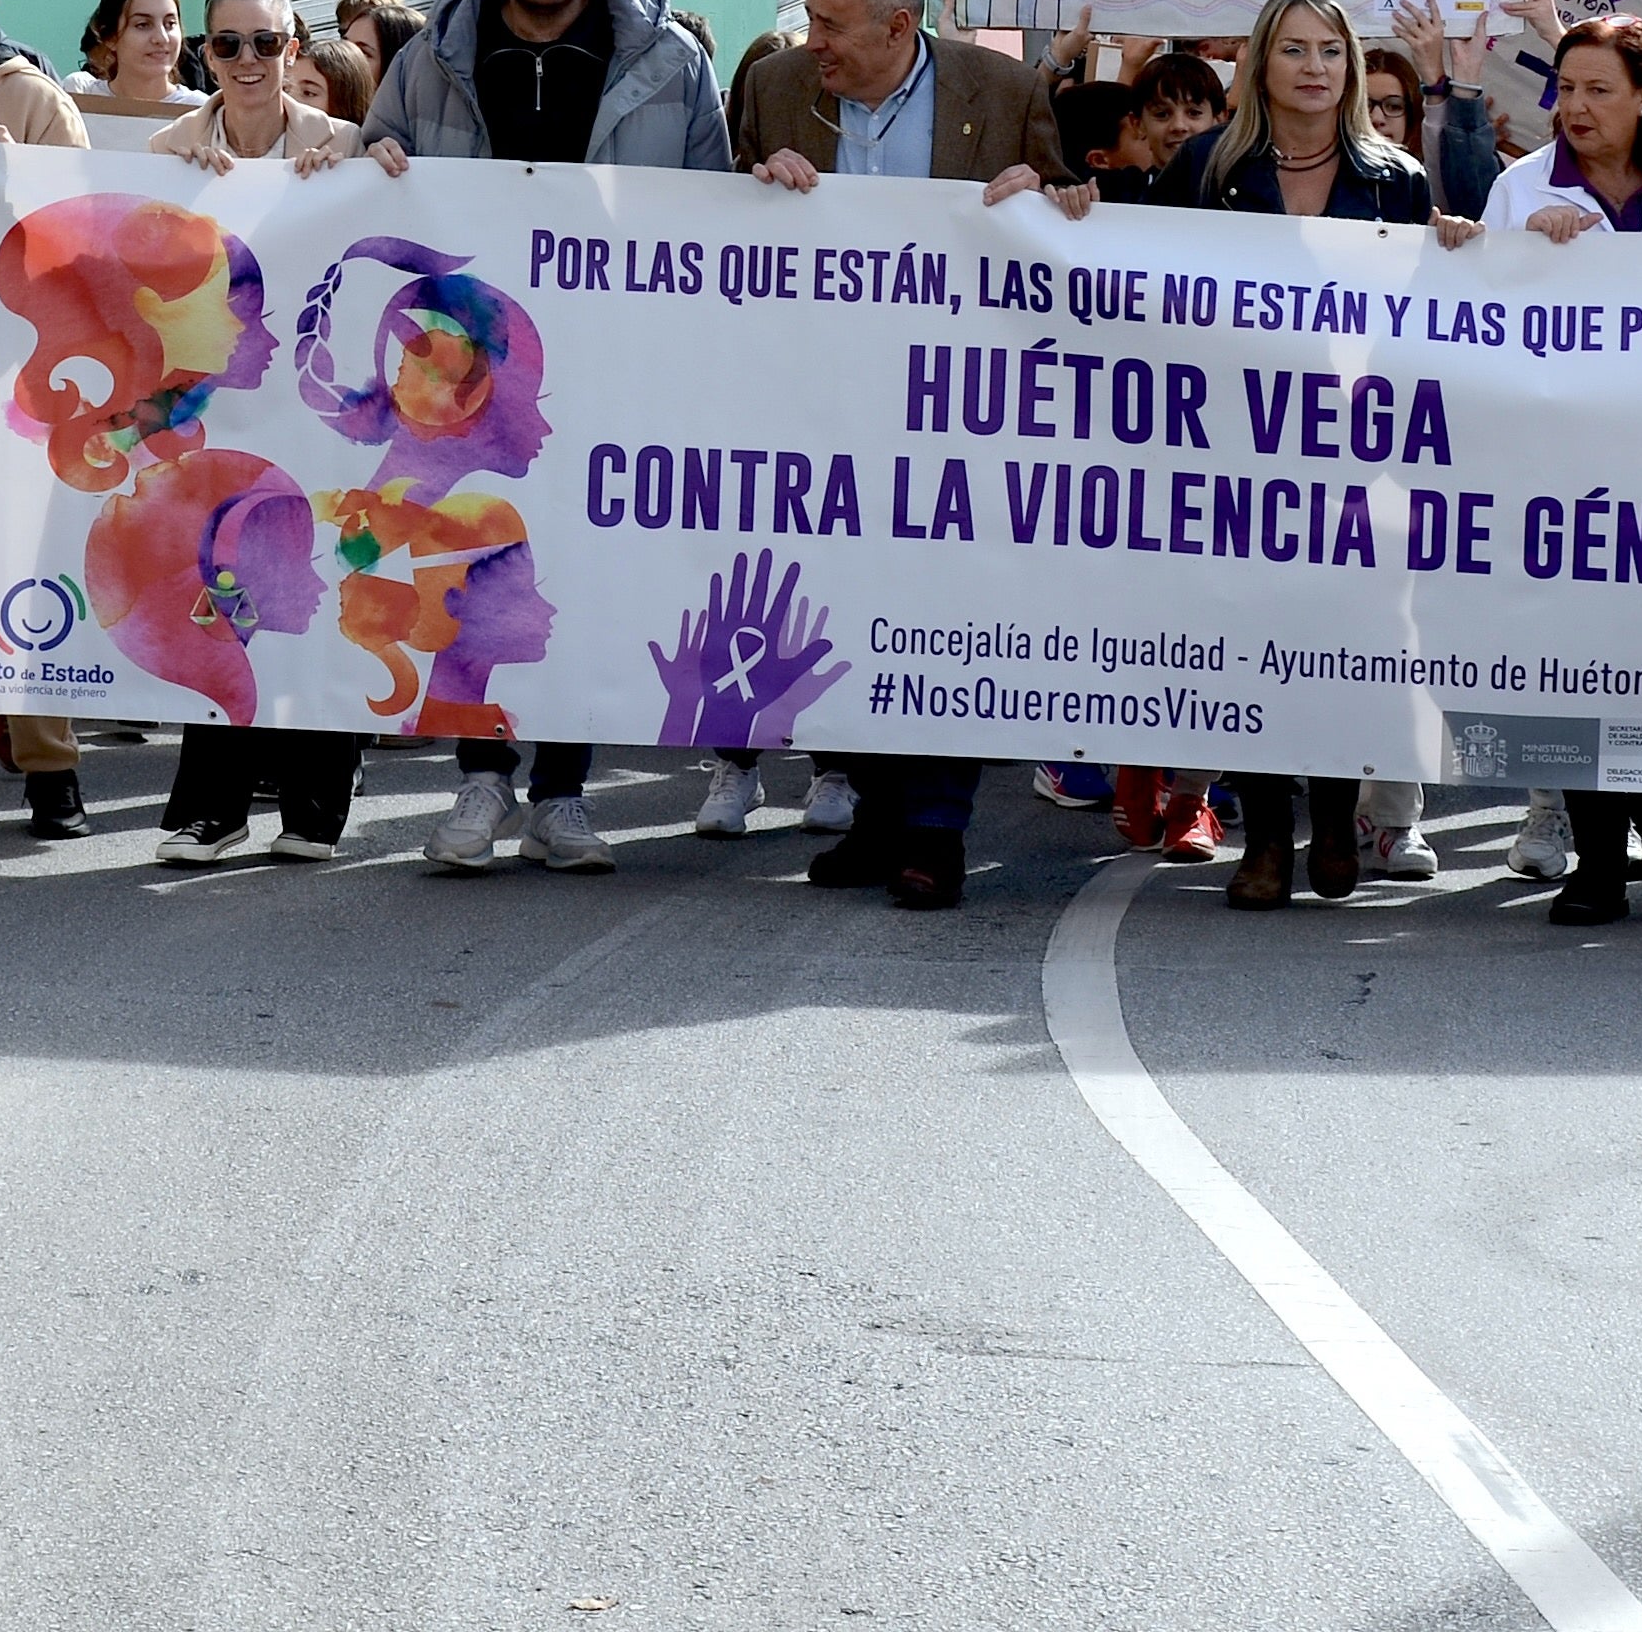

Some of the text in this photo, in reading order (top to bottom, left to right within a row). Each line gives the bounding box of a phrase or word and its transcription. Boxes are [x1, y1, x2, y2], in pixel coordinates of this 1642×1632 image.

[530, 229, 610, 292] POR
[625, 240, 703, 294] LAS
[718, 244, 798, 306] QUE
[813, 243, 962, 315] ESTÁN,
[979, 256, 1053, 314] LAS
[1068, 264, 1148, 326] QUE
[1162, 272, 1218, 327] NO
[1233, 280, 1367, 336] ESTÁN
[1385, 294, 1411, 338] Y
[1428, 298, 1506, 347] LAS
[1522, 304, 1604, 358] QUE
[906, 337, 1452, 466] HUÉTOR VEGA
[587, 443, 862, 537] CONTRA
[892, 455, 975, 542] LA
[1004, 460, 1376, 568] VIOLENCIA
[1407, 488, 1494, 575] DE
[21, 669, 36, 681] de
[41, 662, 114, 684] Estado
[870, 617, 1032, 666] Concejalía
[1044, 625, 1079, 662] de
[1092, 627, 1225, 673] Igualdad
[1260, 640, 1479, 689] Ayuntamiento
[1490, 654, 1527, 692] de
[8, 683, 53, 696] violencia
[55, 686, 68, 697] de
[70, 686, 107, 699] género
[869, 672, 1265, 735] #NosQueremosVivas
[1522, 744, 1580, 754] MINISTERIO
[1522, 754, 1592, 764] DE IGUALDAD
